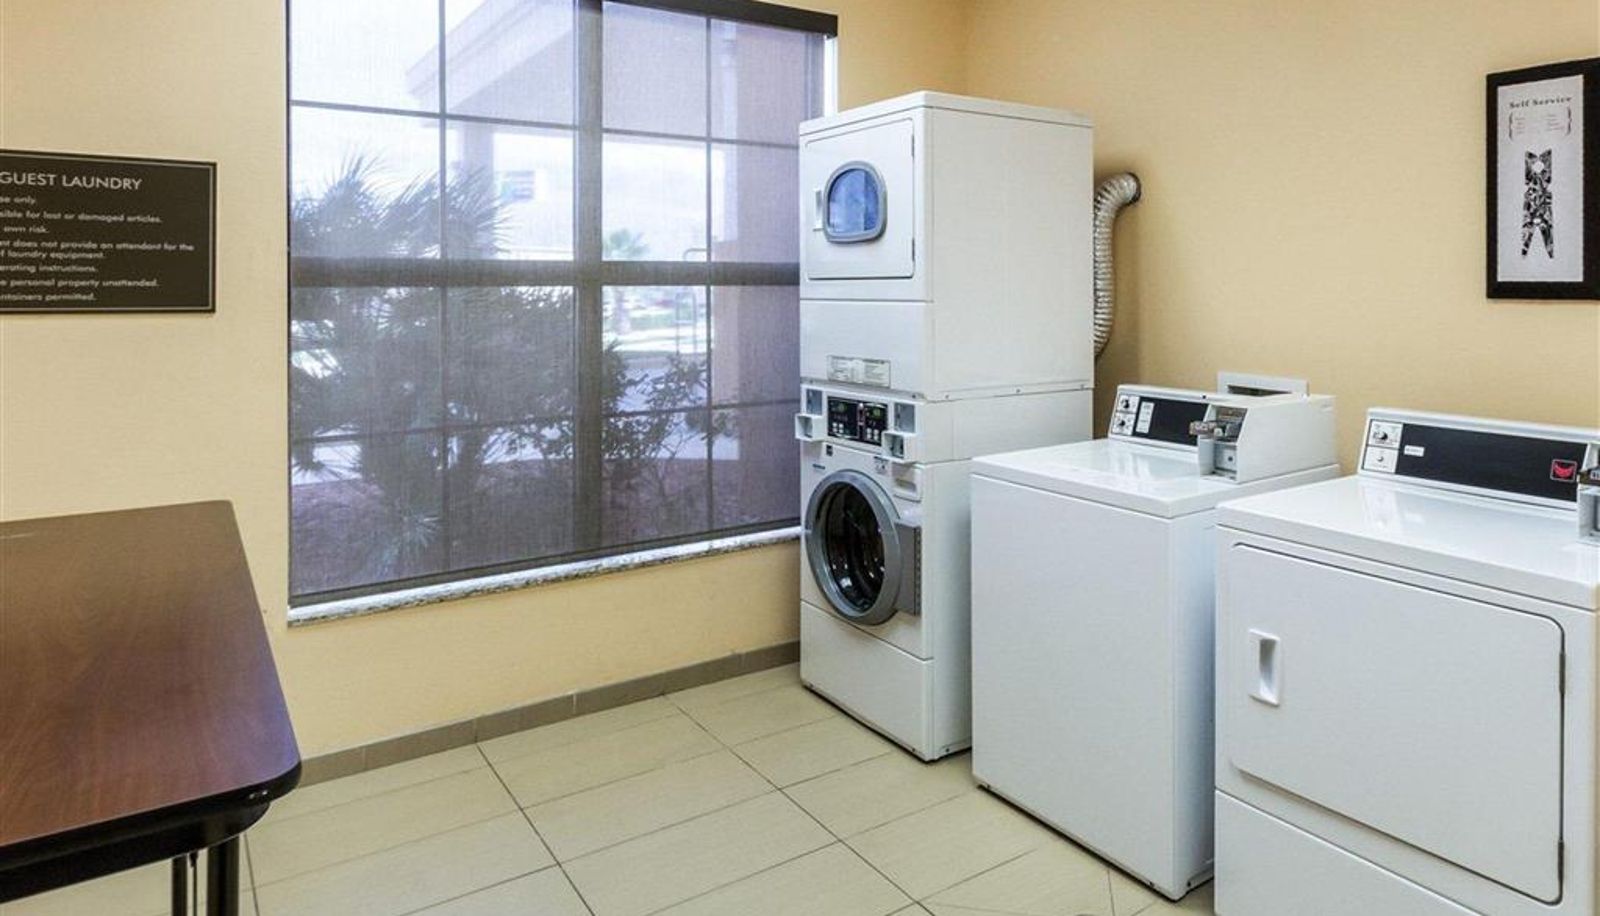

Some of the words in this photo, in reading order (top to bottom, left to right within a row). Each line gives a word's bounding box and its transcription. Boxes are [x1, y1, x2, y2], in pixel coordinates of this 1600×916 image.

[1509, 99, 1529, 108] Self
[1532, 96, 1572, 106] Service
[0, 171, 57, 186] GUEST
[62, 174, 142, 191] LAUNDRY
[26, 209, 40, 219] for
[43, 210, 61, 219] lost
[64, 212, 76, 220] or
[78, 211, 124, 223] damaged
[127, 214, 162, 223] articles.
[29, 224, 49, 233] risk.
[13, 238, 38, 248] does
[40, 240, 58, 248] not
[60, 240, 98, 250] provide
[116, 240, 162, 250] attendant
[163, 241, 177, 252] for
[179, 242, 195, 252] the
[7, 248, 46, 260] laundry
[10, 277, 55, 288] personal
[57, 279, 100, 289] property
